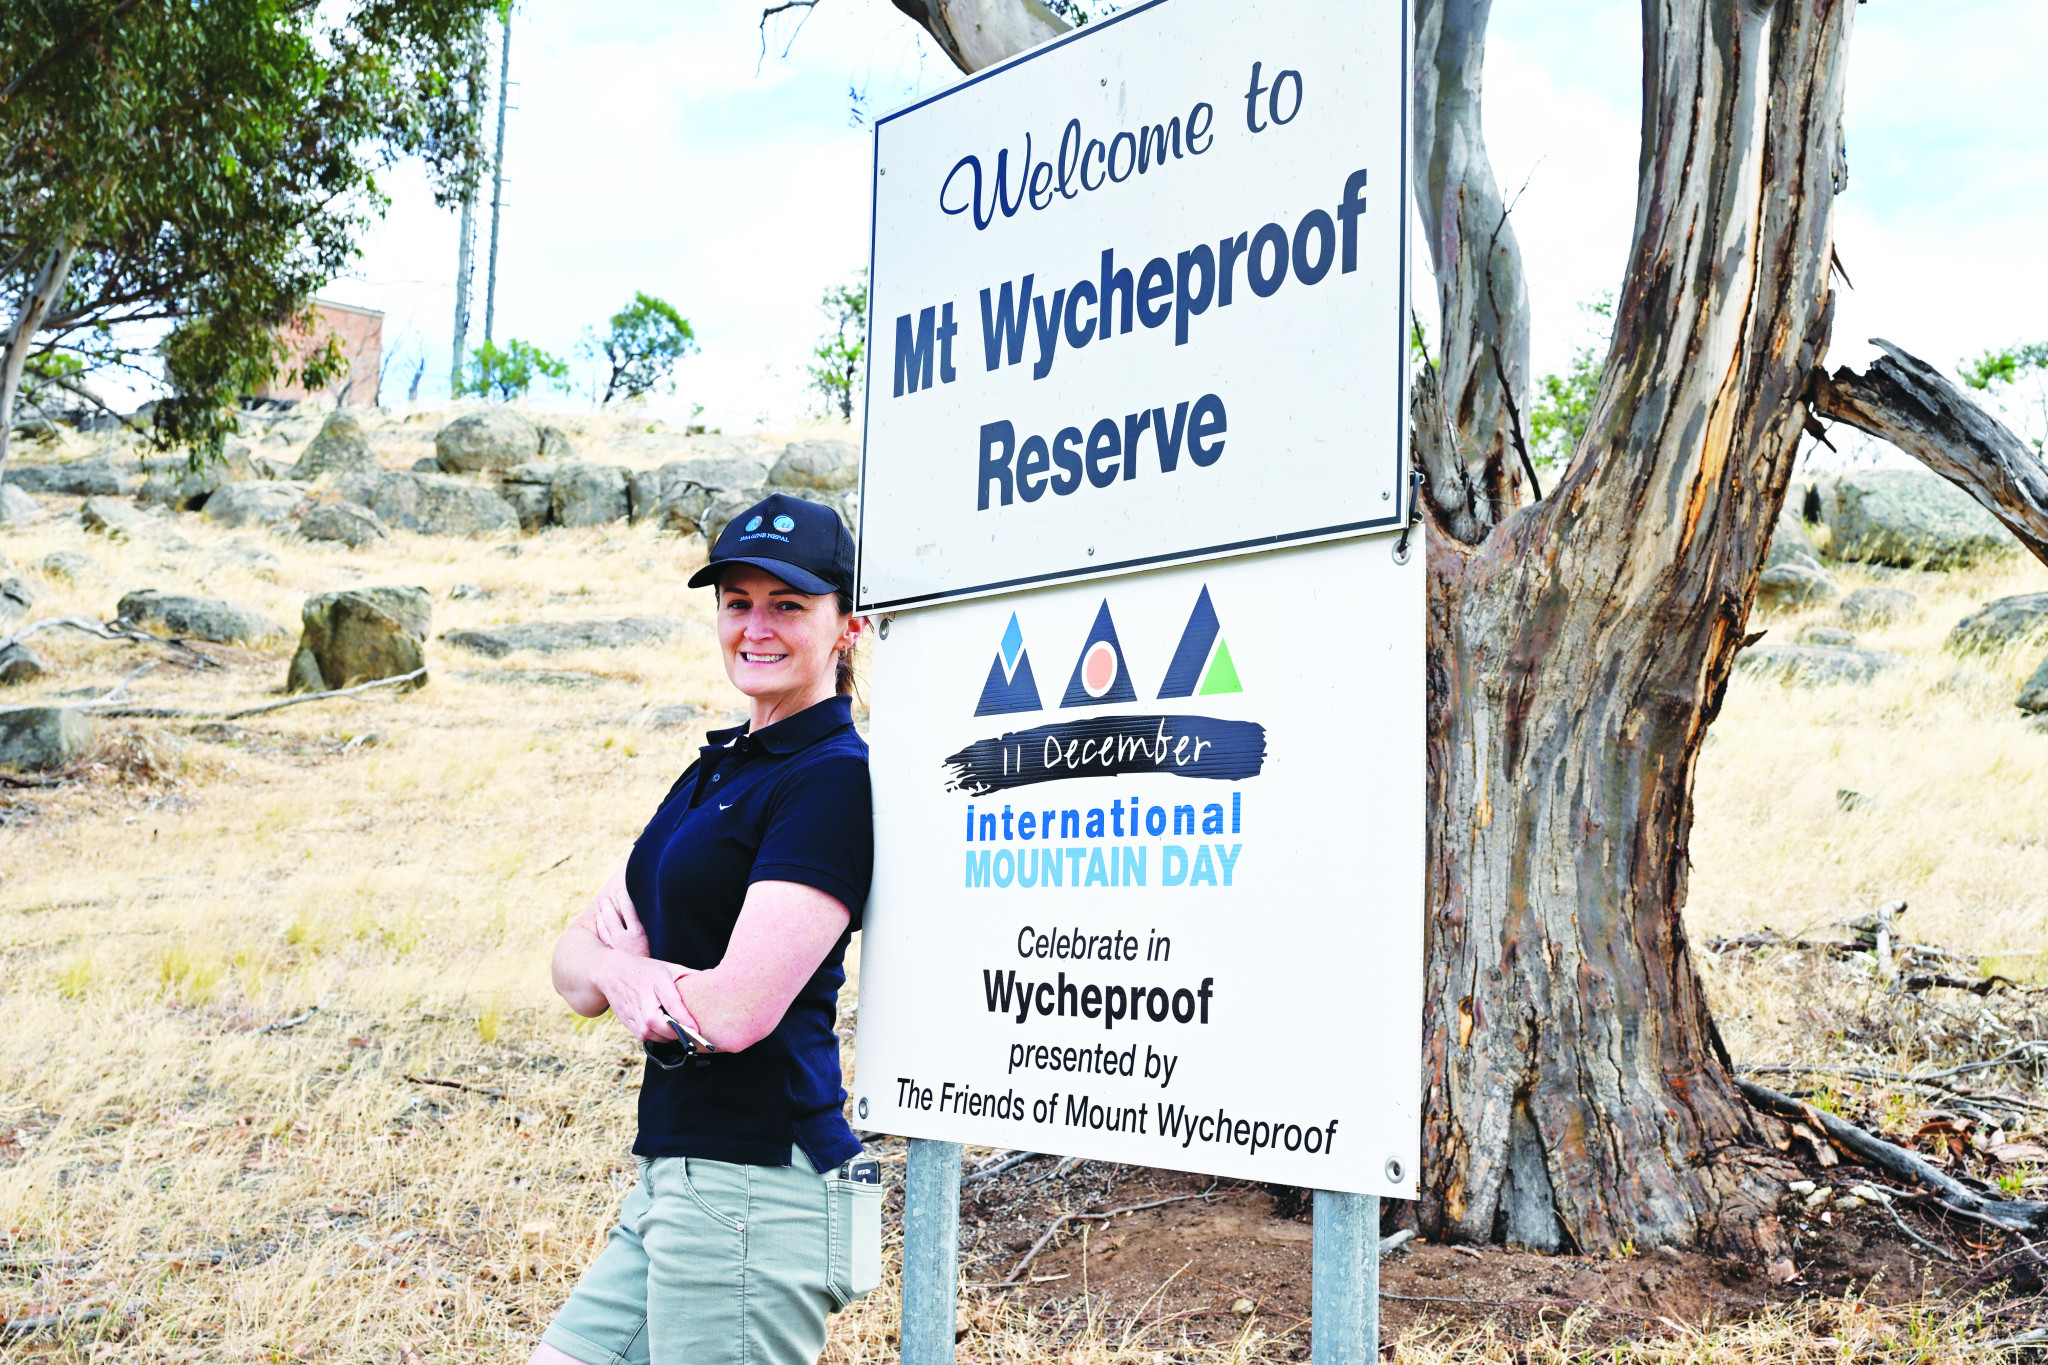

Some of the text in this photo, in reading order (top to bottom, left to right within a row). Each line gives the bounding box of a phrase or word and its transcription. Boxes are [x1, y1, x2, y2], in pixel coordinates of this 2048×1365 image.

[940, 62, 1302, 231] Welcome to
[894, 169, 1367, 399] Mt Wycheproof
[978, 394, 1227, 512] Reserve
[767, 533, 789, 543] NEPAL
[1044, 717, 1211, 769] December
[966, 792, 1242, 842] international
[965, 843, 1243, 889] MOUNTAIN DAY
[1017, 925, 1171, 962] Celebrate in
[983, 970, 1214, 1030] Wycheproof
[1009, 1042, 1178, 1088] presented by
[897, 1078, 1338, 1156] The Friends of Mount Wycheproof
